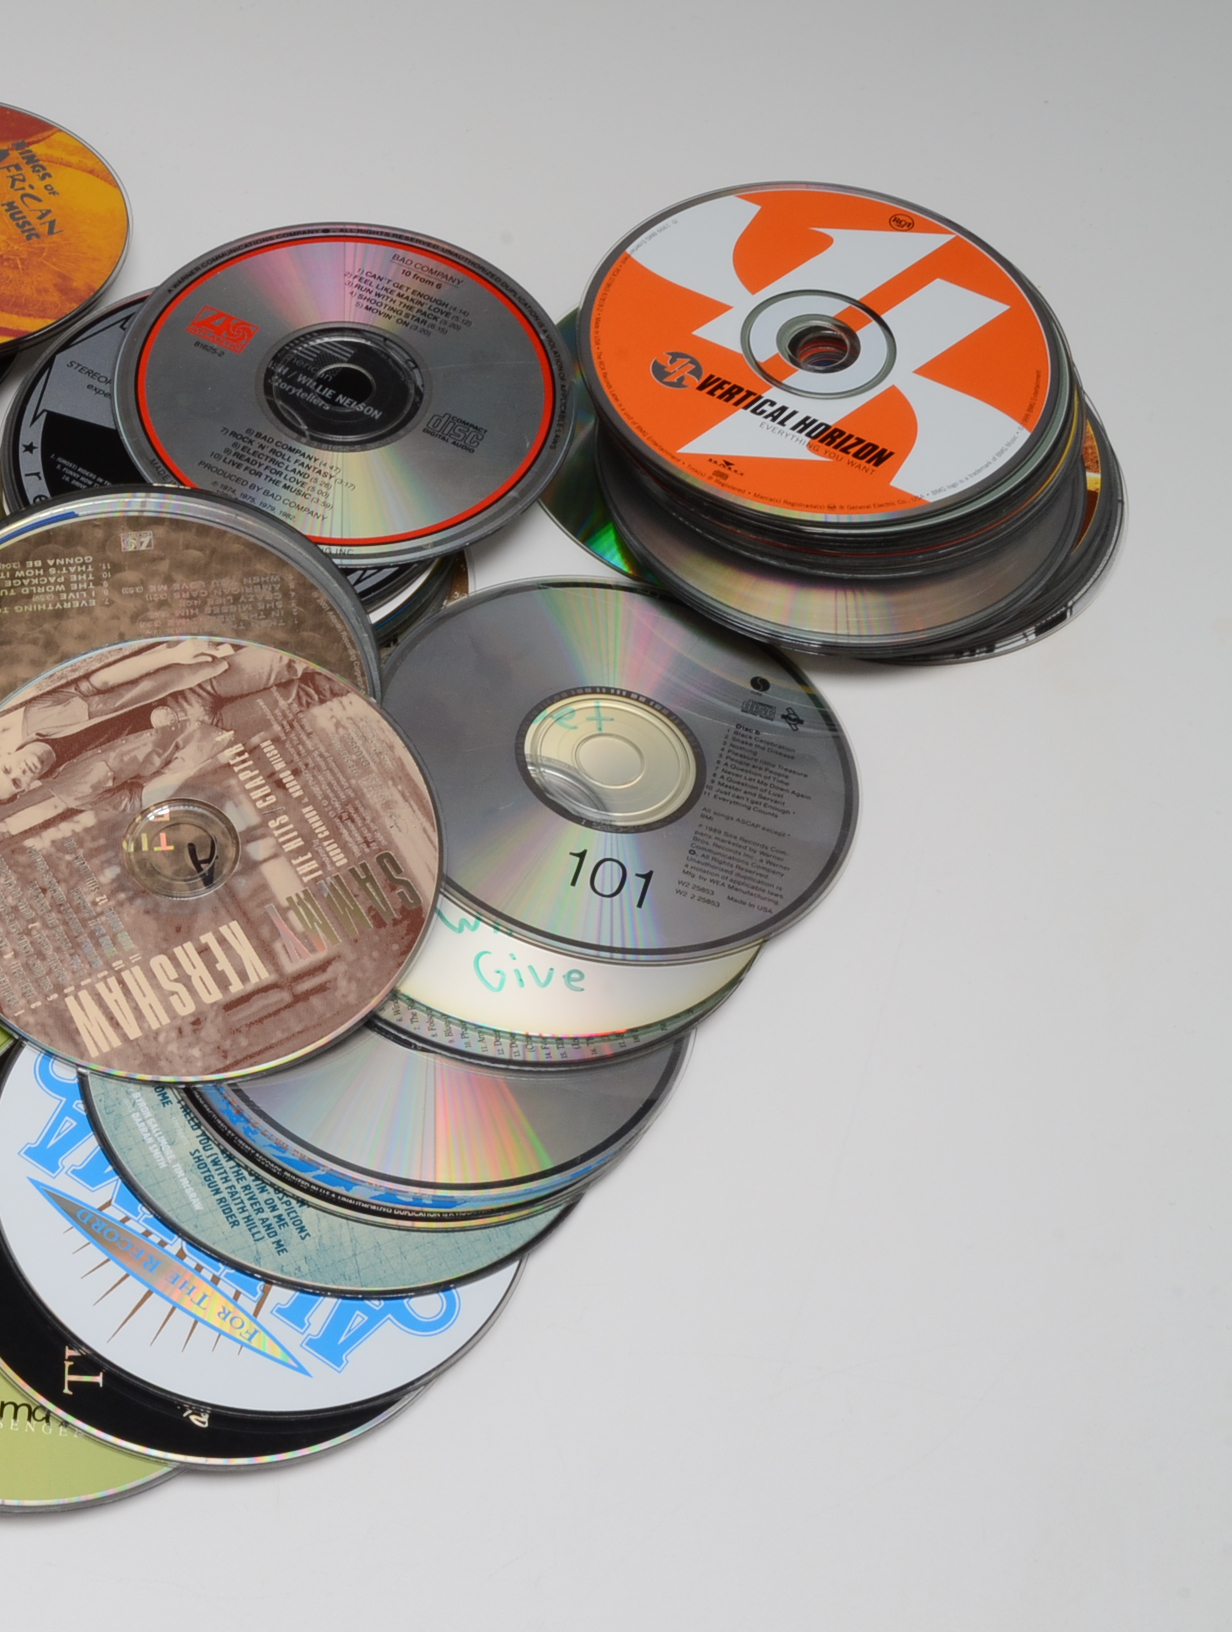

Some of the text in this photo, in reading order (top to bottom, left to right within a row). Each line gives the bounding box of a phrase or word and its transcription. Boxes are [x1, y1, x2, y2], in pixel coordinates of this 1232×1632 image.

[11, 140, 59, 196] KINGS OF
[1, 201, 41, 240] MUSIC
[891, 215, 913, 229] RCA
[392, 253, 464, 285] BAD COMPANY
[401, 269, 411, 277] 10
[413, 273, 433, 286] from
[354, 283, 440, 322] RUN WITH THE PACK
[365, 271, 449, 309] CAN'T GET ENOUGH
[358, 293, 428, 325] SHOOTING STAR
[193, 340, 225, 357] 81625-2
[334, 393, 383, 420] NELSON
[695, 373, 895, 468] VERTICAL HORIZON
[422, 428, 475, 453] DIGITAL AUDIO
[427, 412, 484, 448] disc
[451, 416, 488, 434] COMPACT
[241, 446, 311, 479] ELECTRIC LAND
[759, 421, 877, 476] EVERYTHING YOU WANT
[198, 460, 328, 522] PRODUCED BY BAD COMPANY
[222, 456, 312, 500] LIVE FOR THE MUSIC
[15, 569, 44, 577] HOW
[47, 555, 93, 566] GONNA
[5, 576, 65, 587] PACKAGE
[21, 585, 66, 595] WORLD
[70, 582, 95, 590] THE
[15, 599, 96, 613] EVERYTHING
[260, 740, 286, 771] WILSON
[730, 743, 758, 756] Nothing
[733, 730, 796, 753] Black Celebration
[714, 794, 778, 818] Everything Counts
[718, 781, 741, 792] Master
[758, 794, 785, 806] Servant
[224, 743, 323, 883] THE HITS CHAPTER
[302, 805, 330, 838] CANNON
[568, 848, 654, 909] 101
[265, 851, 424, 966] SAMMY
[473, 950, 587, 993] Give
[64, 920, 270, 1059] KERSHAW
[131, 1113, 168, 1170] DARRAN SMITH
[173, 1163, 183, 1178] TIM
[189, 1149, 240, 1229] SHOTGUN RIDER
[225, 1184, 265, 1243] FAITH HILL)
[241, 1184, 288, 1256] RIVER AND ME
[75, 1206, 161, 1275] RECORD
[158, 1274, 208, 1312] THE
[218, 1307, 261, 1344] FOR
